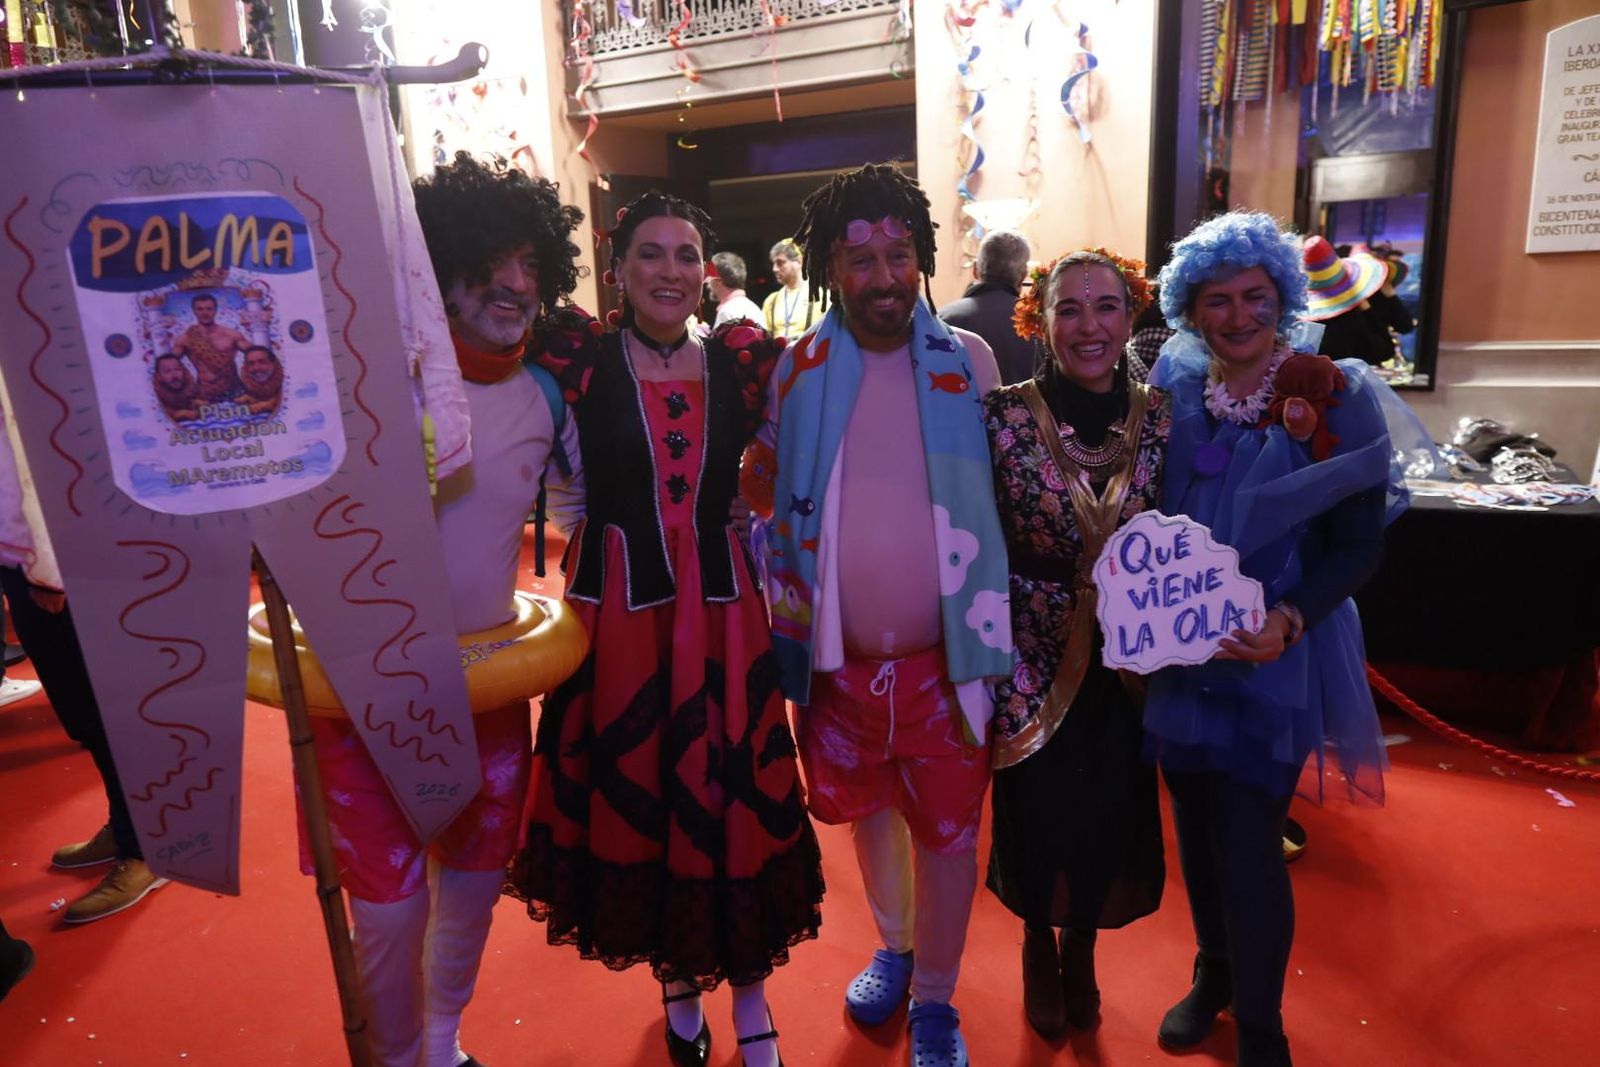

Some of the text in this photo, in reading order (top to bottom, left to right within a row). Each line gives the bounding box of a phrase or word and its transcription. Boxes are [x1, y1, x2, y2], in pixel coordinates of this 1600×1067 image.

[1568, 44, 1583, 57] LA
[1557, 134, 1583, 144] GRAN
[88, 212, 294, 278] PALMA
[199, 403, 250, 420] Plan
[201, 439, 265, 463] Local
[1118, 622, 1155, 656] LA
[415, 783, 461, 797] 2026
